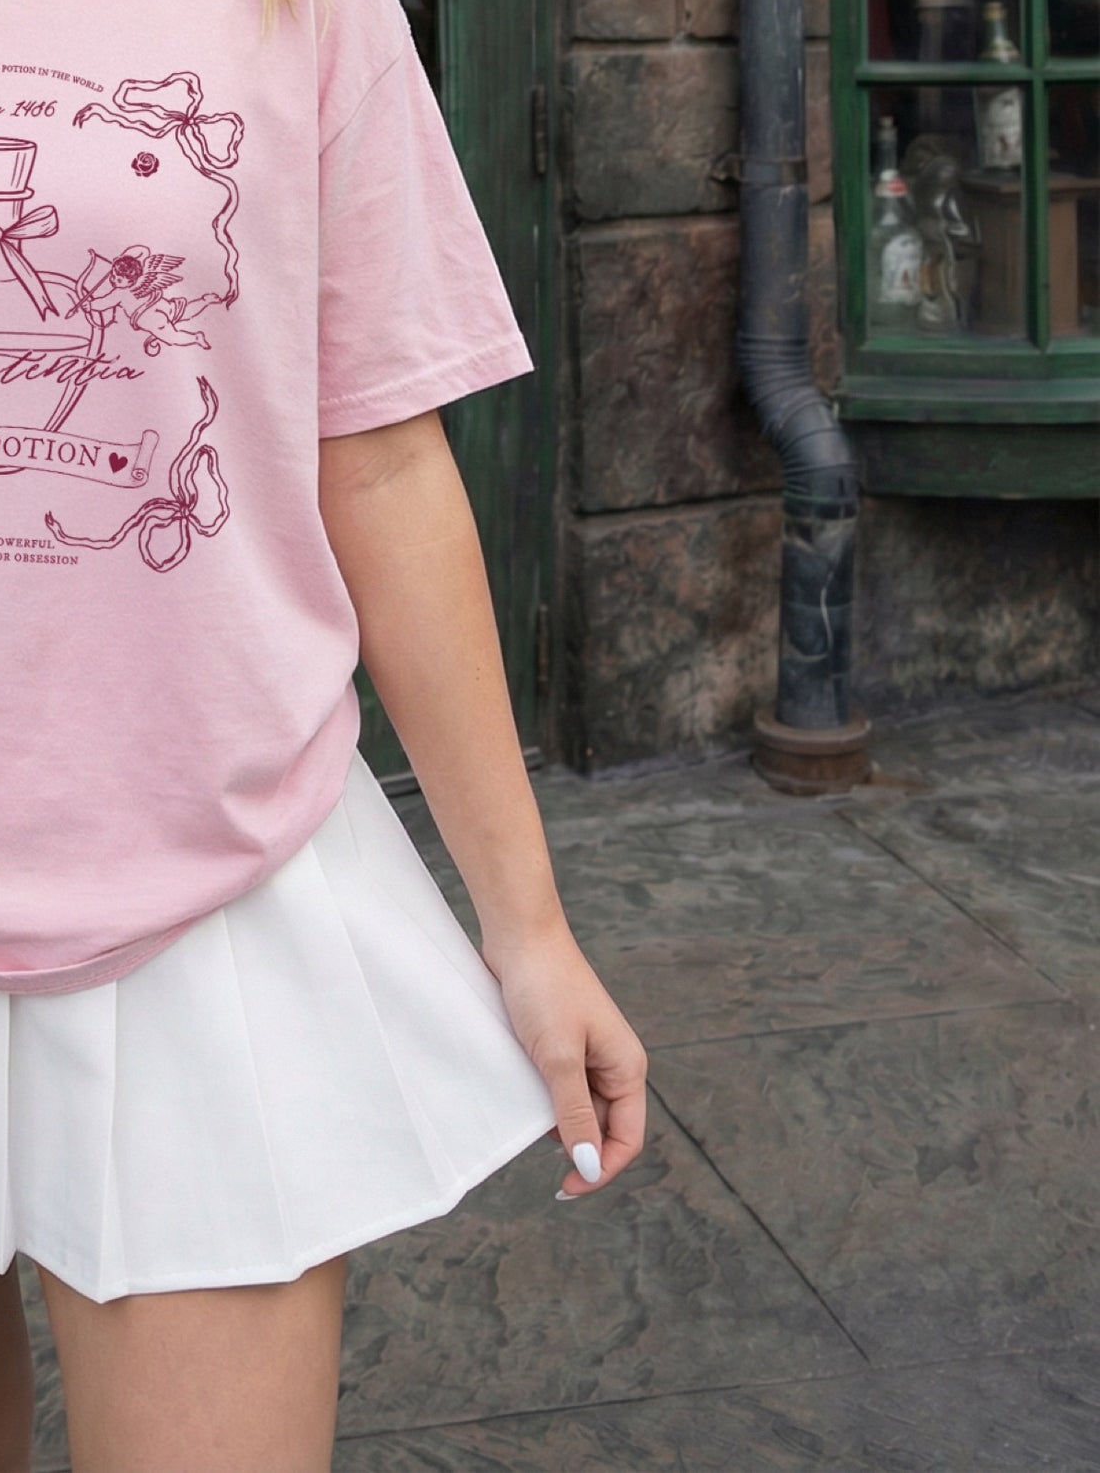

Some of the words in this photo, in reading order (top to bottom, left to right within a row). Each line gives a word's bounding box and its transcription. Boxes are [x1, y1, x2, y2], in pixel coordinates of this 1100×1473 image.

[2, 64, 36, 75] POTION
[38, 67, 50, 77] IN
[50, 69, 71, 82] THE
[72, 75, 104, 94] WORLD
[10, 100, 58, 117] 1486
[14, 552, 79, 565] OBSESSION
